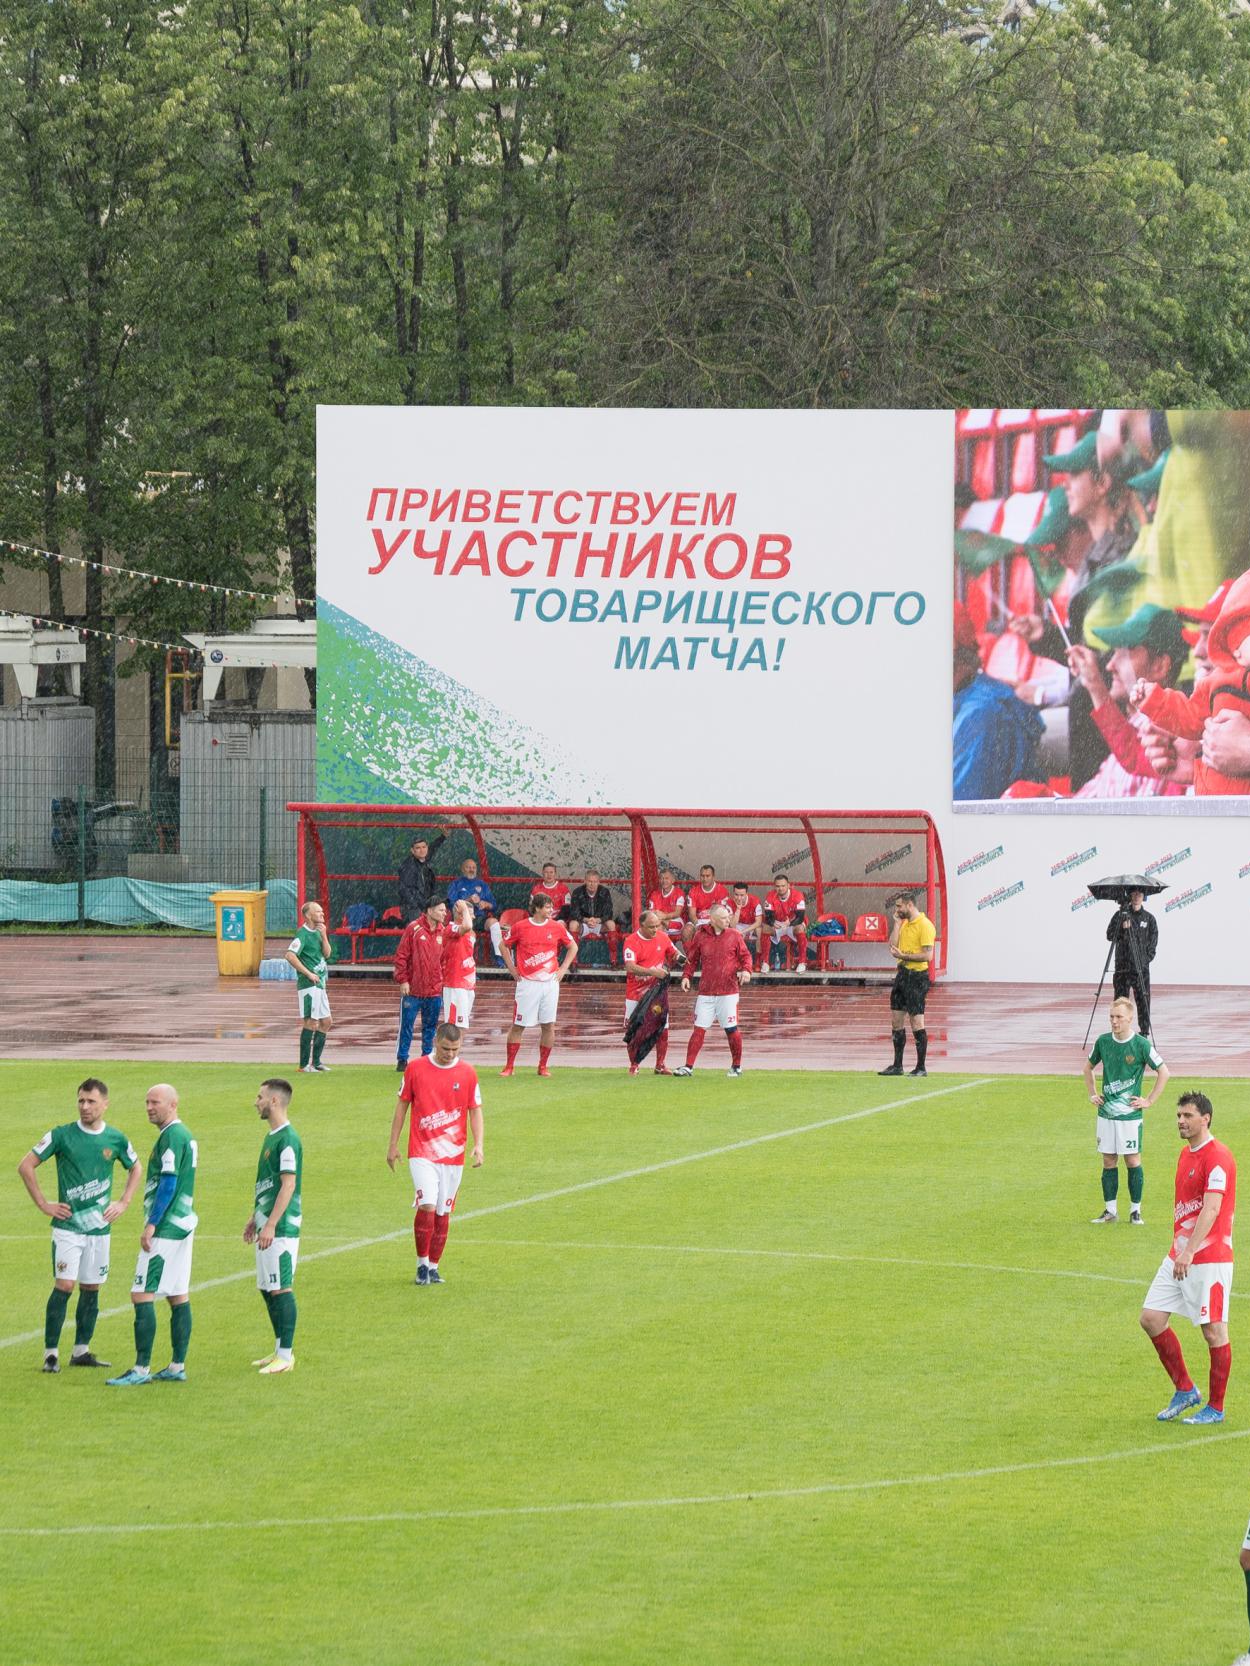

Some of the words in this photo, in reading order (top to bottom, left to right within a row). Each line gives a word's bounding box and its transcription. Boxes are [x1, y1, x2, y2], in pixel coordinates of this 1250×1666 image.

[366, 487, 738, 526] ПРИВЕТСТВУЕМ
[368, 529, 793, 580] УЧАСТНИКОВ
[509, 587, 927, 633] ТОВАРИЩЕСКОГО
[613, 635, 787, 672] МАТЧА!
[1126, 1140, 1137, 1148] 21
[1200, 1306, 1207, 1316] 5
